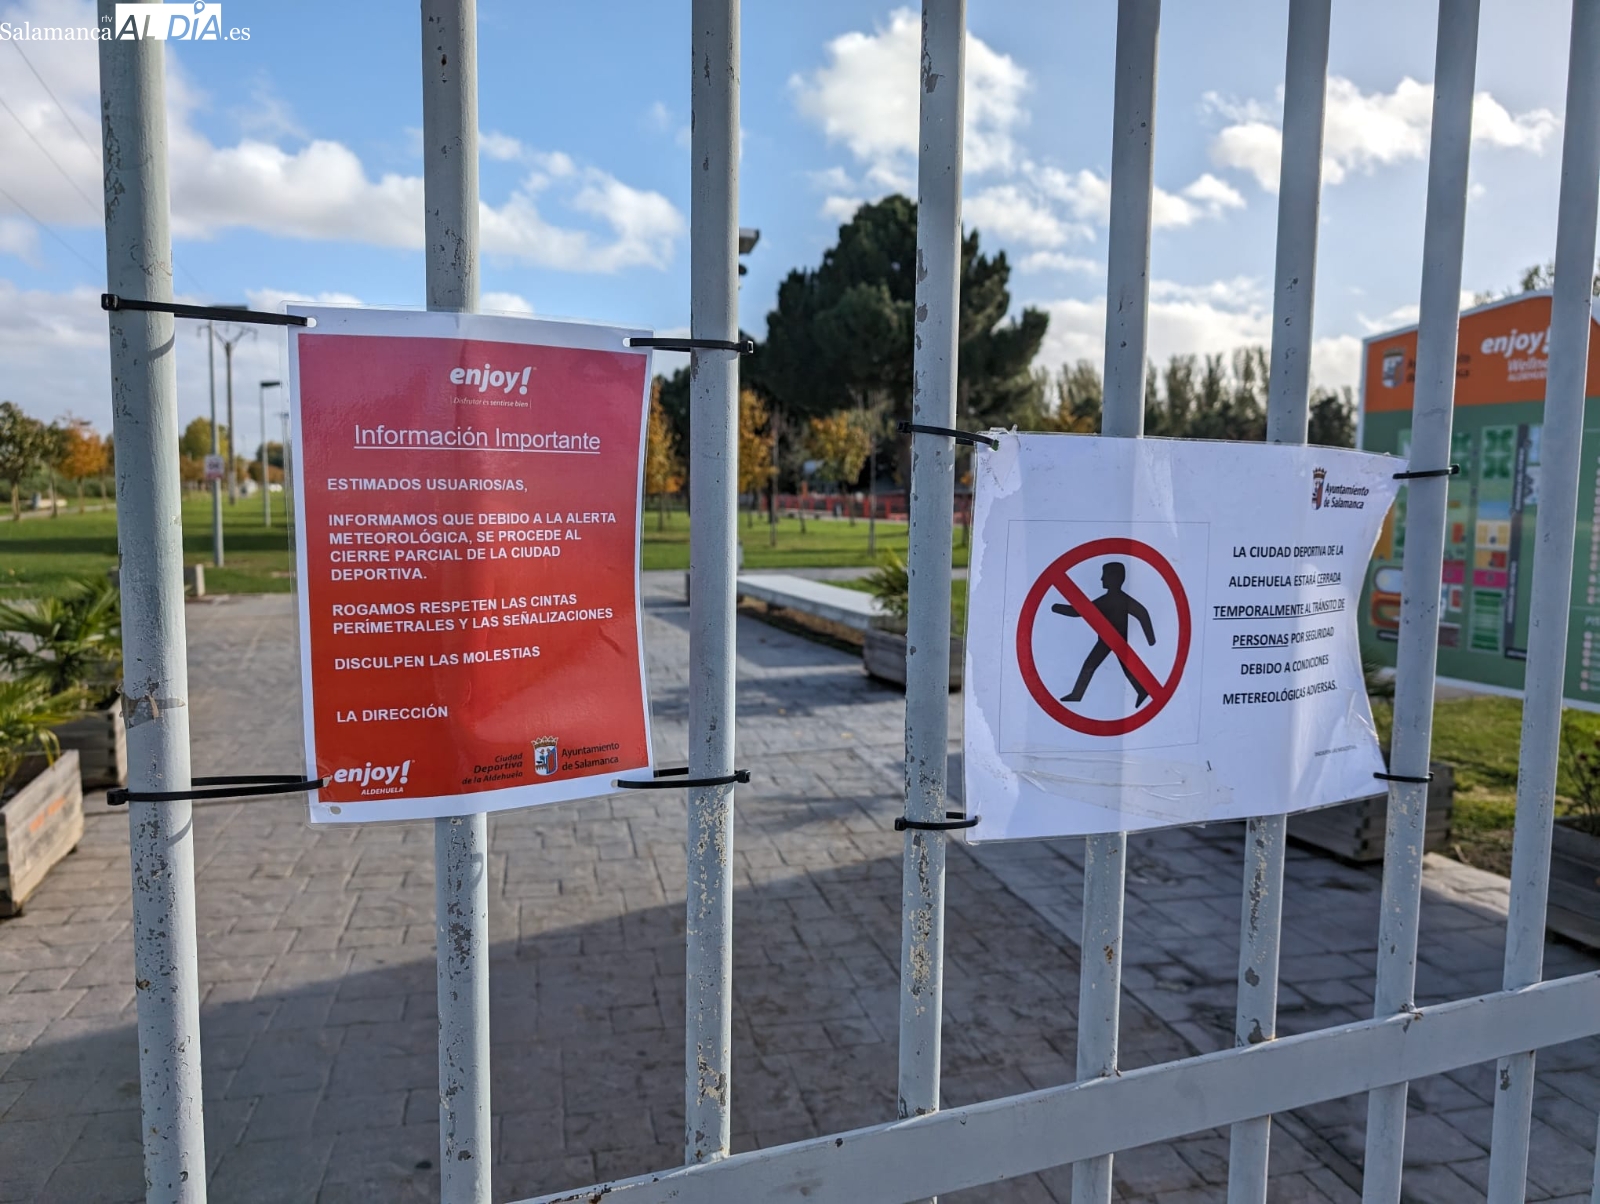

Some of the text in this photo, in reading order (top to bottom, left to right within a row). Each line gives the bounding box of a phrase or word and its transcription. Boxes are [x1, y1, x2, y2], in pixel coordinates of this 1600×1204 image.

[450, 363, 532, 395] enjoy!
[490, 399, 514, 407] sentirse
[354, 424, 601, 452] Información Importante
[327, 478, 528, 492] ESTIMADOS USUARIOS/AS,
[1325, 482, 1369, 496] Ayuntamiento
[1324, 497, 1365, 510] de Salamanca
[328, 512, 616, 527] INFORMAMOS QUE DEBIDO A LA ALERTA
[329, 528, 581, 545] METEOROLÓGICA, SE PROCEDE AL
[330, 545, 561, 563] CIERRE PARCIAL DE LA CIUDAD
[1233, 545, 1344, 558] LA CIUDAD DEPORTIVA DE LA
[331, 566, 427, 581] DEPORTIVA.
[1229, 572, 1341, 587] ALDEHUELA ESTARÁ CERRADA
[332, 593, 577, 616] ROGAMOS RESPETEN LAS CINTAS
[1213, 598, 1345, 617] TEMPORALMENTE AL TRÁNSITO DE
[333, 607, 613, 635] PERÍMETRALES Y LAS SEÑALIZACIONES
[1232, 626, 1335, 647] PERSONAS POR SEGURIDAD
[335, 646, 540, 670] DISCULPEN LAS MOLESTIAS
[1240, 654, 1329, 675] DEBIDO A CONDICIONES
[1222, 680, 1338, 704] METEREOLÓGICAS ADVERSAS.
[337, 704, 448, 723] LA DIRECCIÓN
[495, 753, 523, 763] Ciudad
[561, 742, 620, 759] Ayuntamiento
[473, 761, 523, 774] Deportiva
[562, 756, 619, 771] de Salamanca
[334, 759, 410, 787] enjoy!
[461, 770, 523, 785] de la Aldehuela
[361, 786, 404, 796] ALDEHUELA
